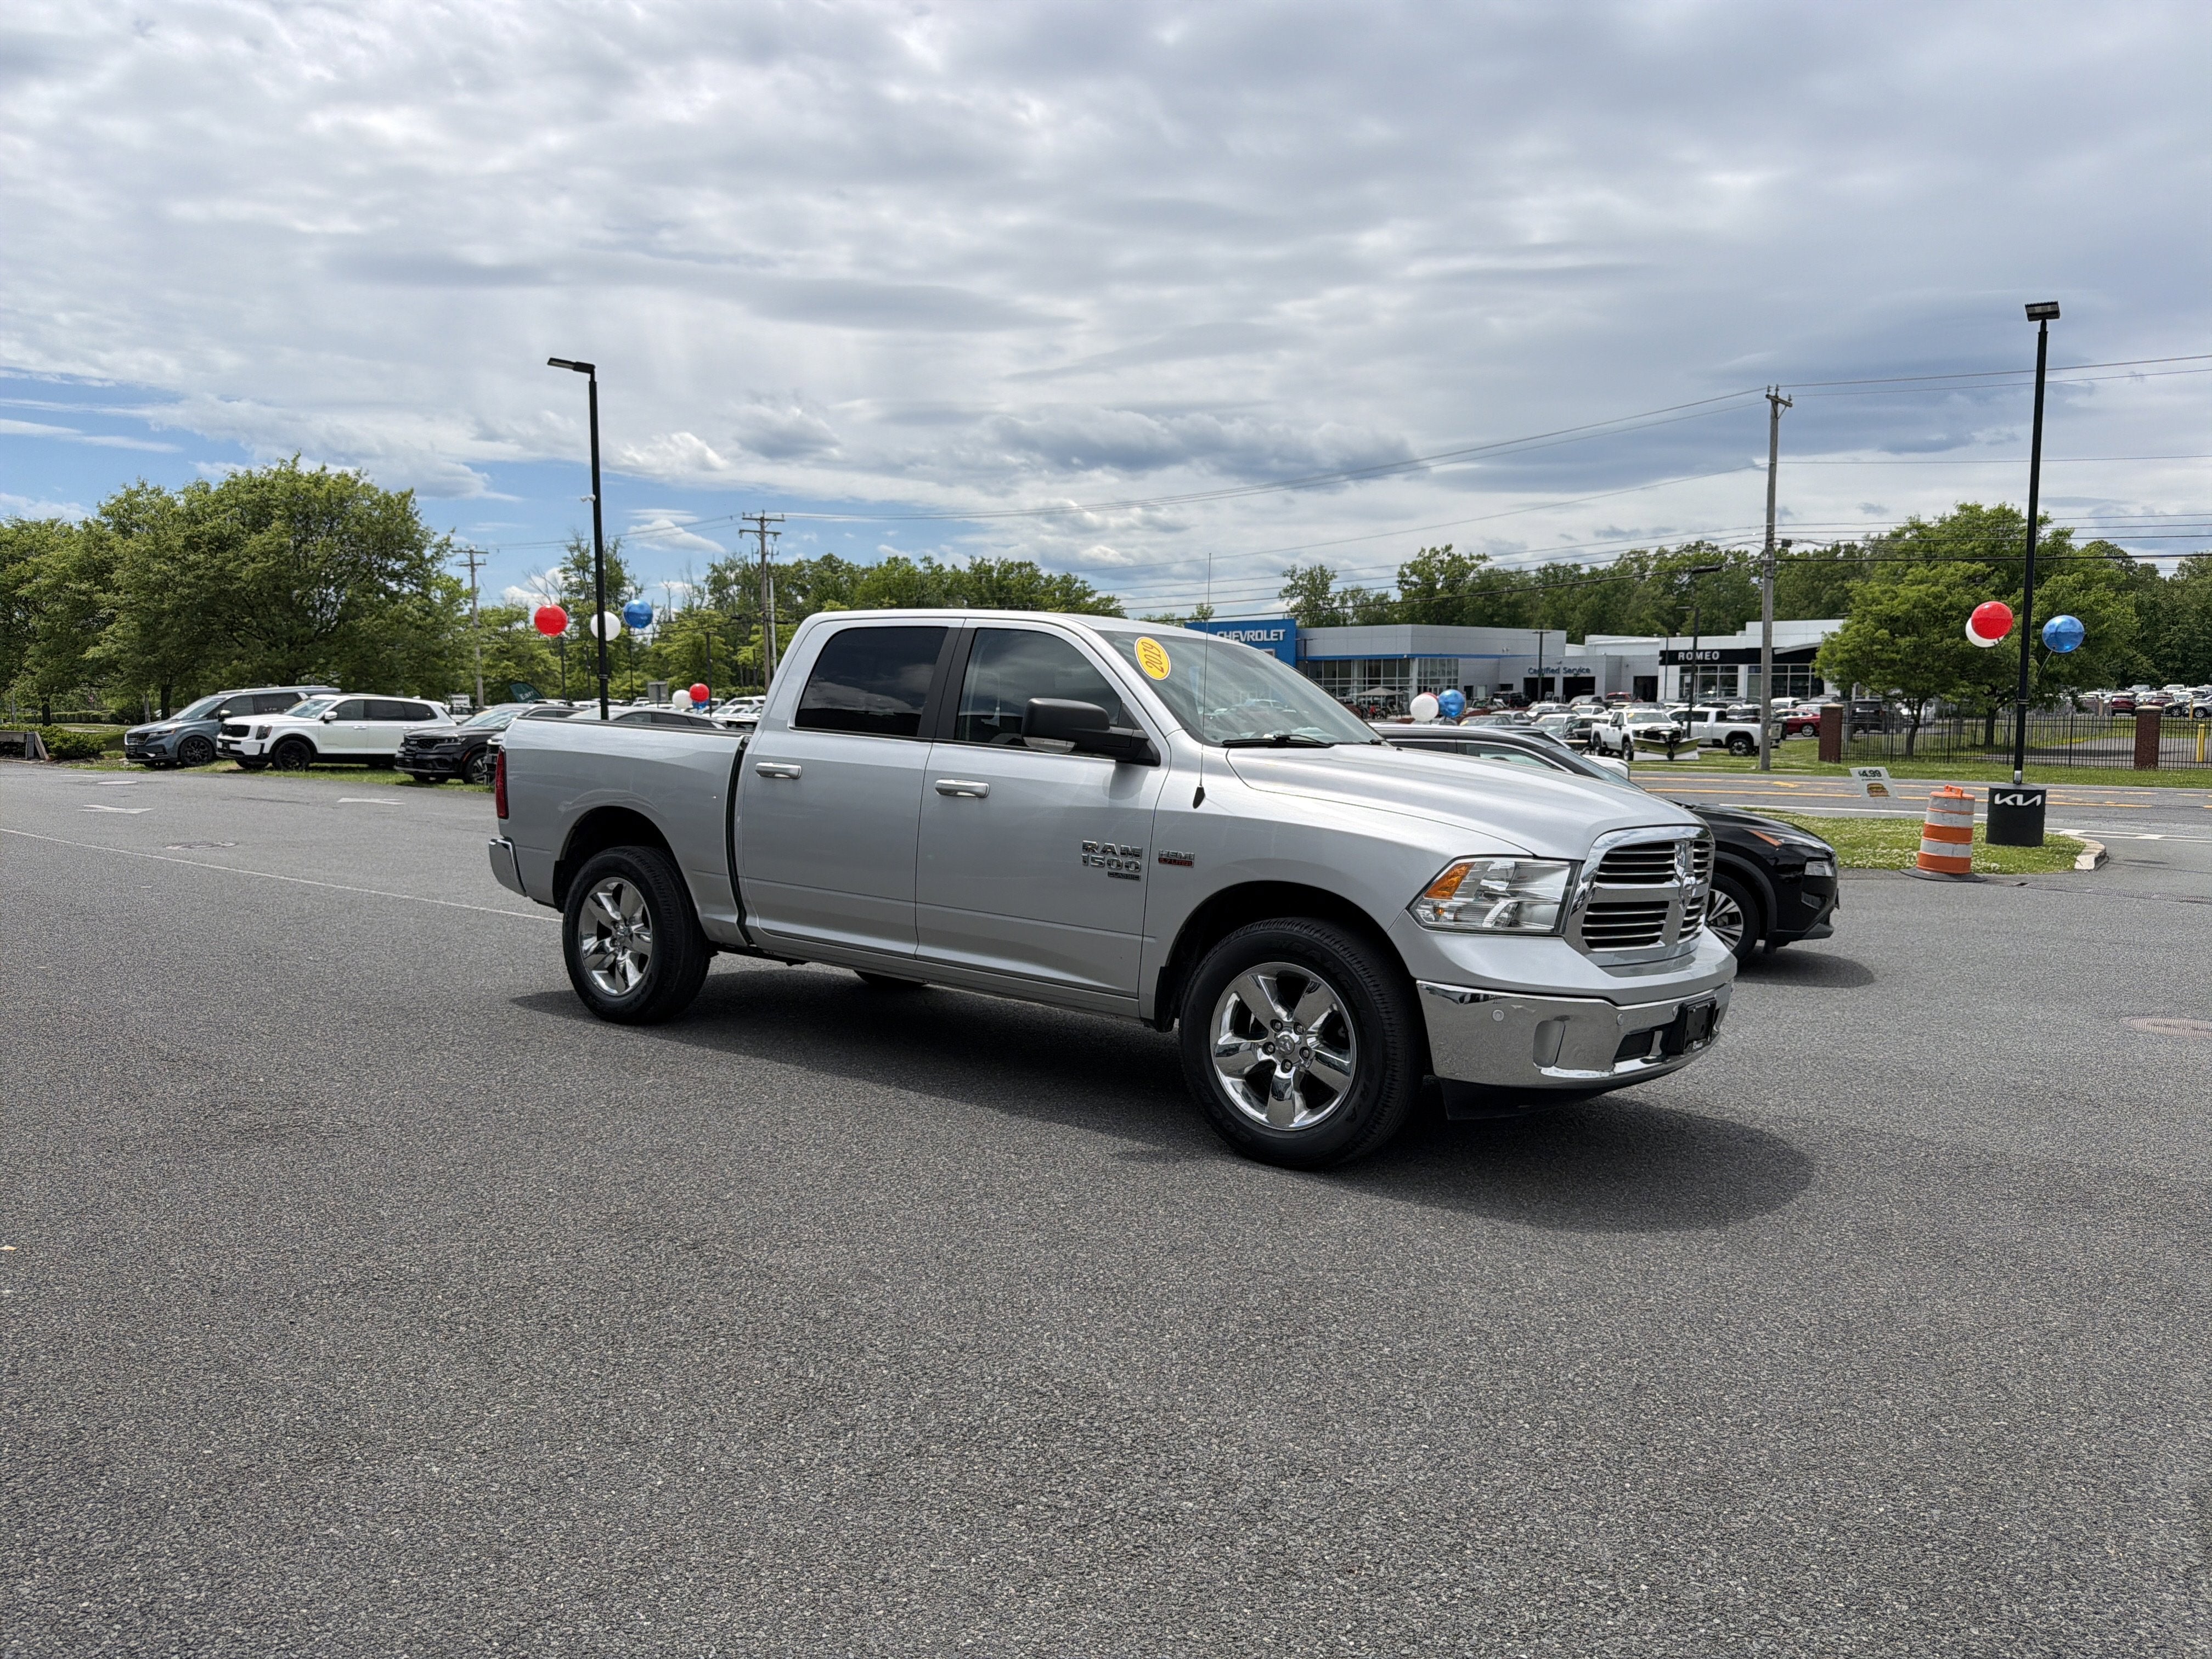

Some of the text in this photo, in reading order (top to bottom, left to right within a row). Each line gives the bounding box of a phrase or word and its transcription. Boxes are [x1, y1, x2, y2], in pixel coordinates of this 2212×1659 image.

[1141, 642, 1164, 674] 2019
[1678, 651, 1720, 661] ROMEO
[1995, 793, 2041, 806] KIA
[1082, 840, 1143, 859] RAM
[1159, 849, 1195, 860] HEMI
[1082, 854, 1141, 873] 1500
[1108, 871, 1141, 881] CLASSIC
